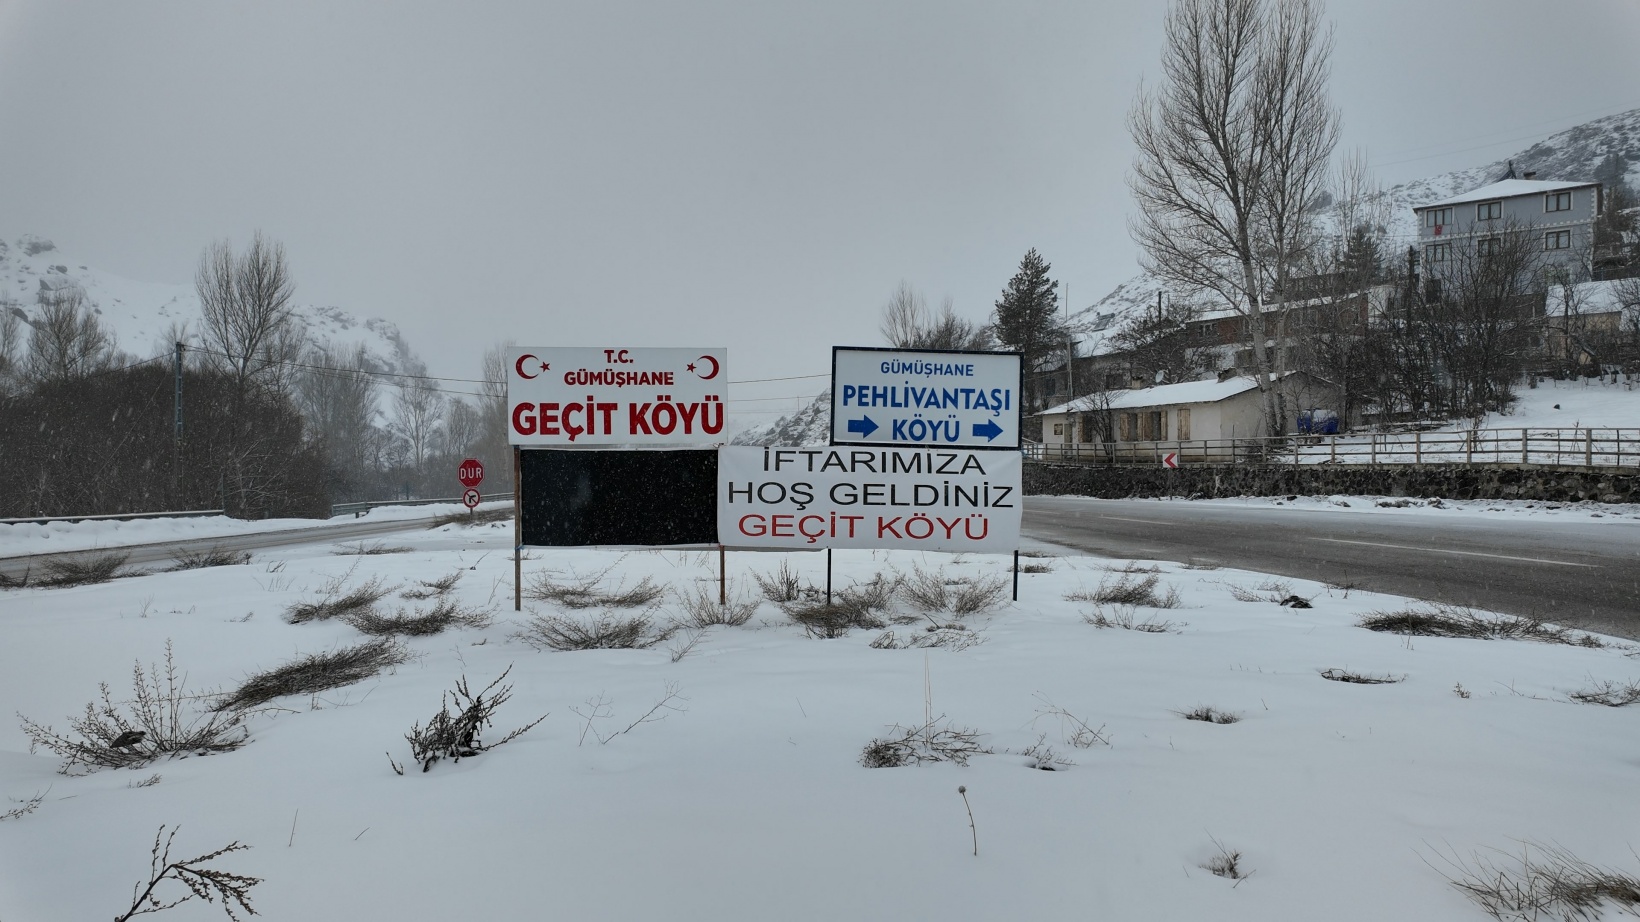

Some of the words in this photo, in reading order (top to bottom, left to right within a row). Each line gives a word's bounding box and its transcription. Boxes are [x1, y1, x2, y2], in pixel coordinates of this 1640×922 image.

[603, 349, 634, 364] T.C.
[880, 358, 974, 379] GÜMÜŞHANE
[563, 368, 674, 388] GÜMÜŞHANE
[842, 380, 1011, 417] PEHLİVANTAŞI
[511, 395, 618, 442] GEÇİT
[629, 395, 724, 436] KÖYÜ
[892, 413, 960, 443] KÖYÜ
[460, 467, 482, 480] DUR
[728, 481, 815, 511] HOŞ
[829, 480, 1014, 509] GELDİNİZ
[738, 511, 865, 544] GEÇİT
[877, 513, 989, 541] KÖYÜ
